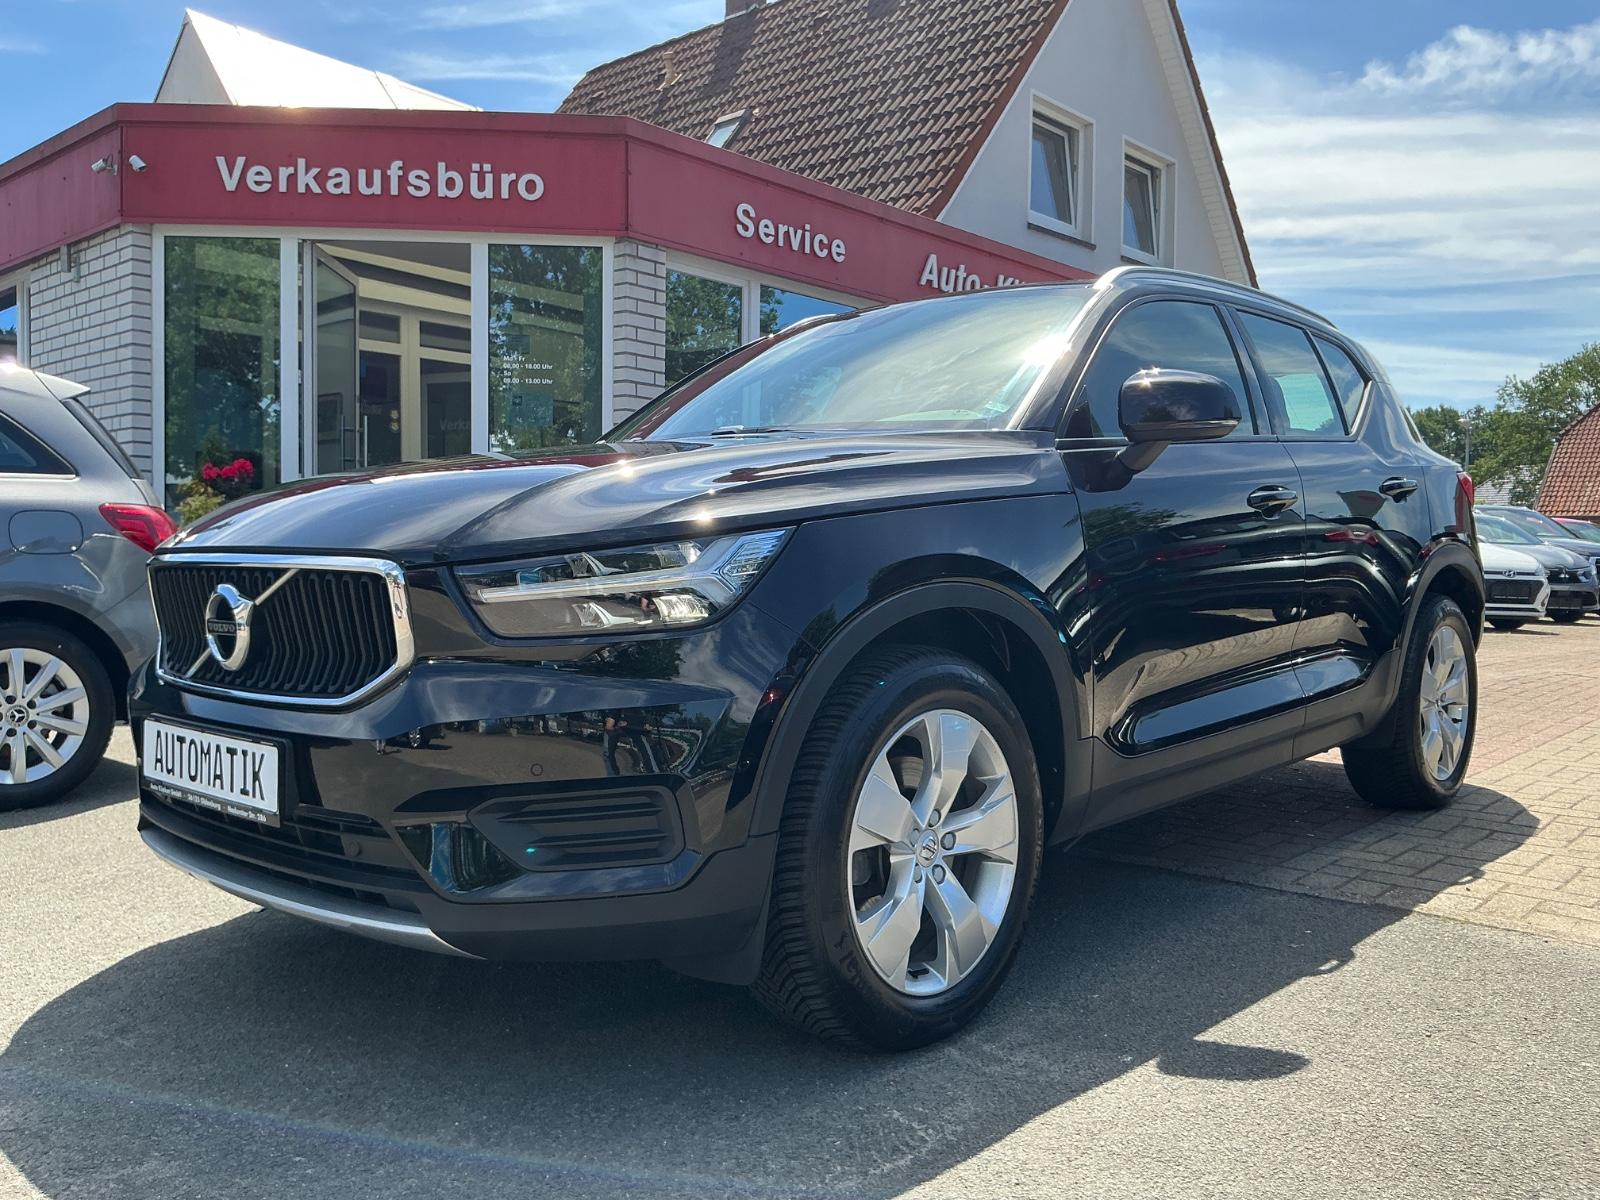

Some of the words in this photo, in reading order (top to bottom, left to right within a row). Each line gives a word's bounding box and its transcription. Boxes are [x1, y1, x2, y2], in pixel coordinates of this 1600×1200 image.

[215, 156, 545, 201] Verkaufsbüro
[736, 203, 846, 263] Service
[207, 622, 236, 633] VOLVO
[154, 729, 266, 801] AUTOMATIK
